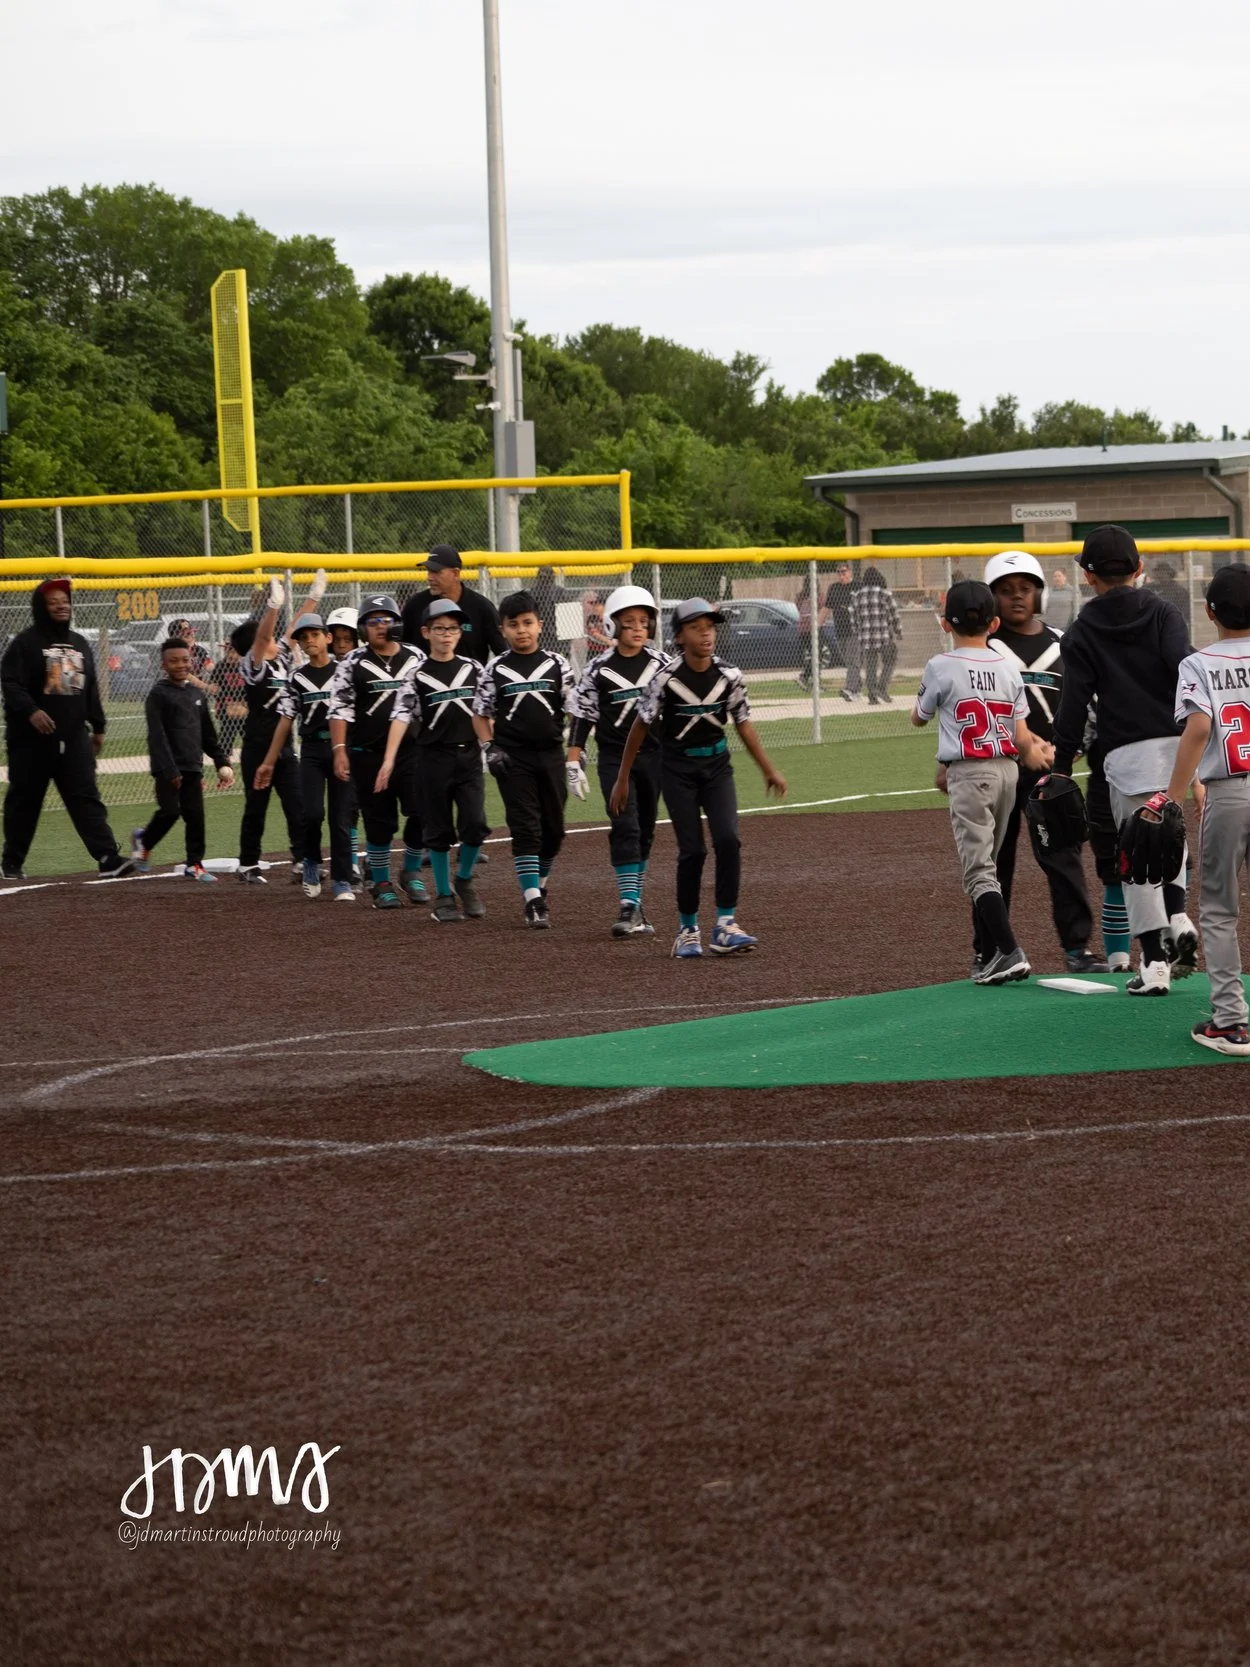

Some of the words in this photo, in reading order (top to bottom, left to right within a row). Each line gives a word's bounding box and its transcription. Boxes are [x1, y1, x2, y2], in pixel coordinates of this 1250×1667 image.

[116, 590, 160, 621] 200
[968, 669, 996, 692] FAIN
[954, 697, 1019, 760] 25
